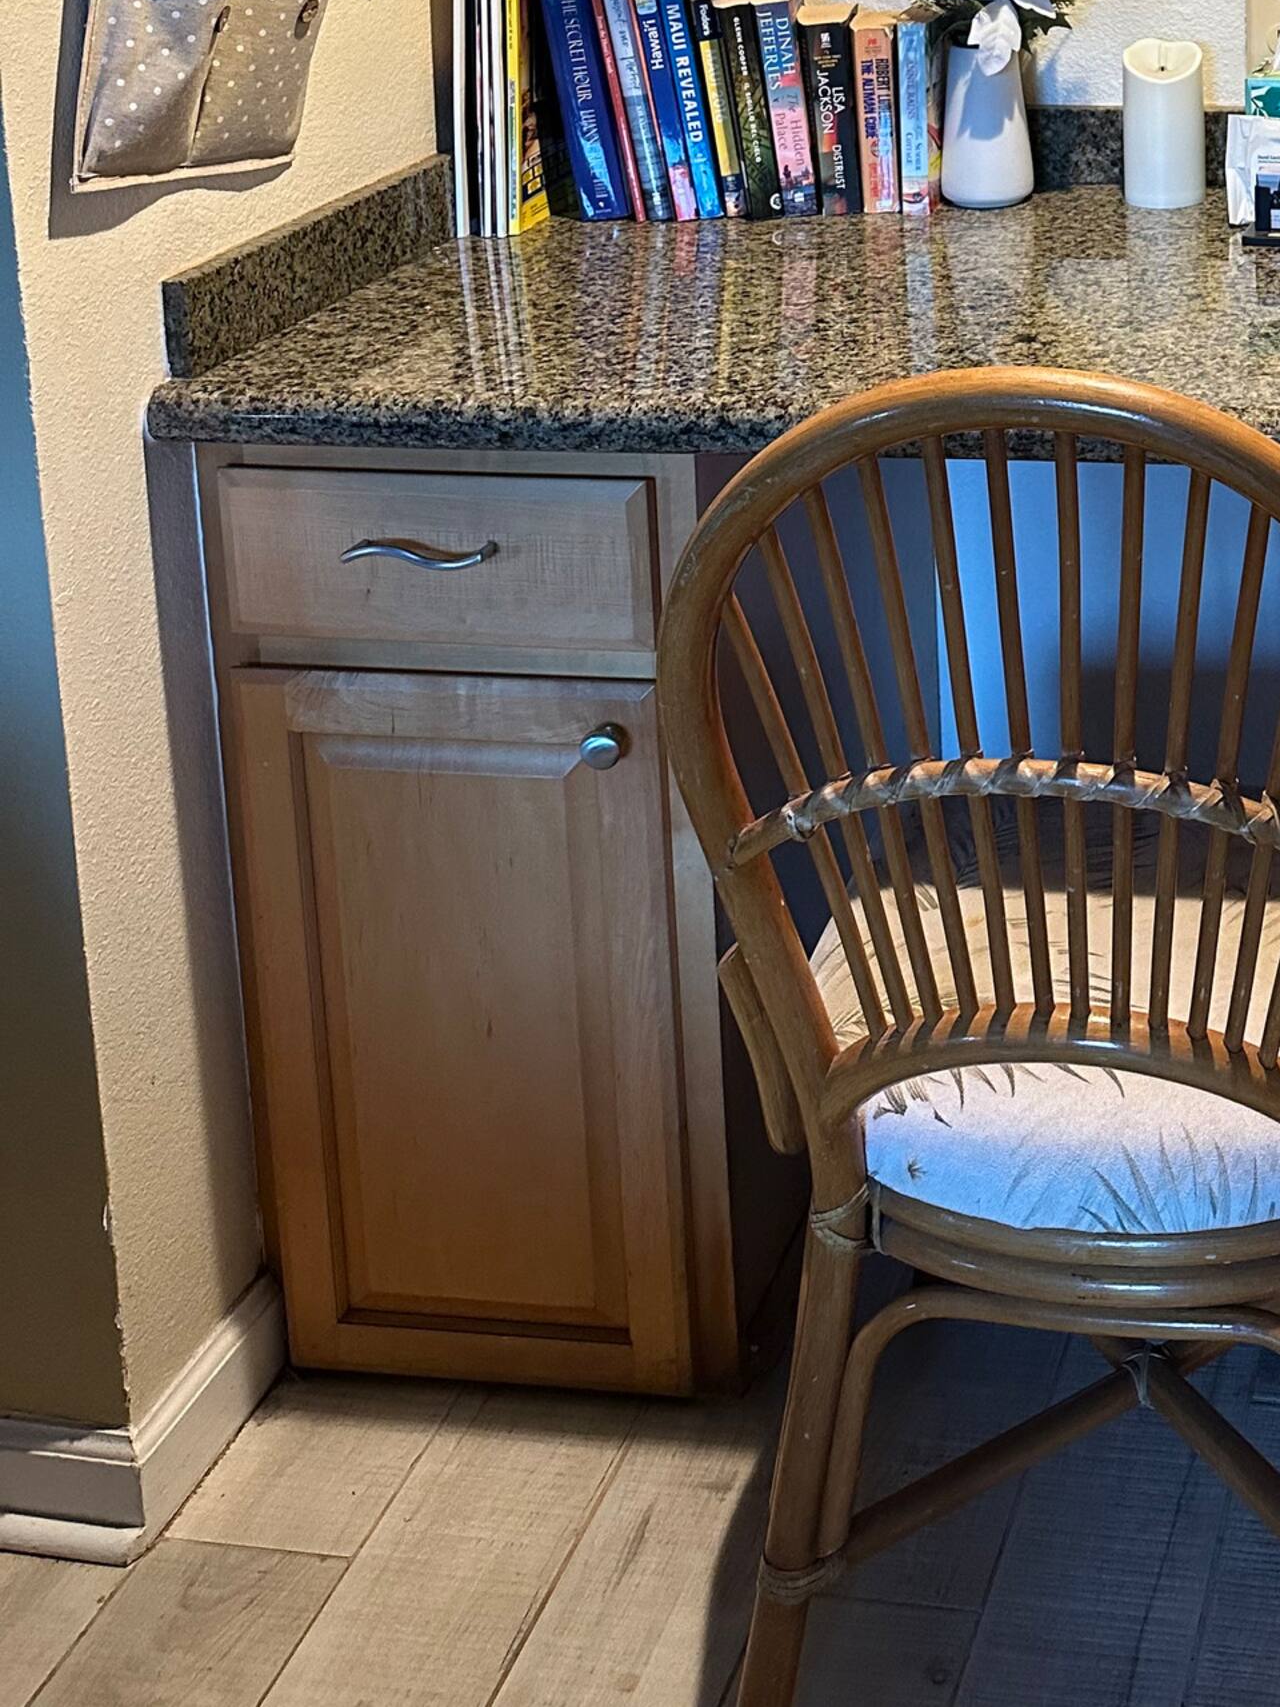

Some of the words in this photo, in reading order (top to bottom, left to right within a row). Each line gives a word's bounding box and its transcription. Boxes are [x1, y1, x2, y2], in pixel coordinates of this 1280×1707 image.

[563, 18, 586, 62] SECRET
[664, 4, 686, 49] MAUI
[776, 18, 795, 75] DINAH
[756, 11, 782, 89] JEFFERIES
[860, 59, 873, 74] THE
[571, 66, 593, 102] HOUR
[875, 58, 890, 90] ROBERT
[674, 56, 704, 142] REVEALED
[786, 94, 800, 112] The
[815, 70, 835, 133] JACKSON
[831, 86, 846, 113] LISA
[774, 113, 790, 150] Palace
[790, 120, 807, 165] Hidden
[831, 144, 846, 188] DISTRUST
